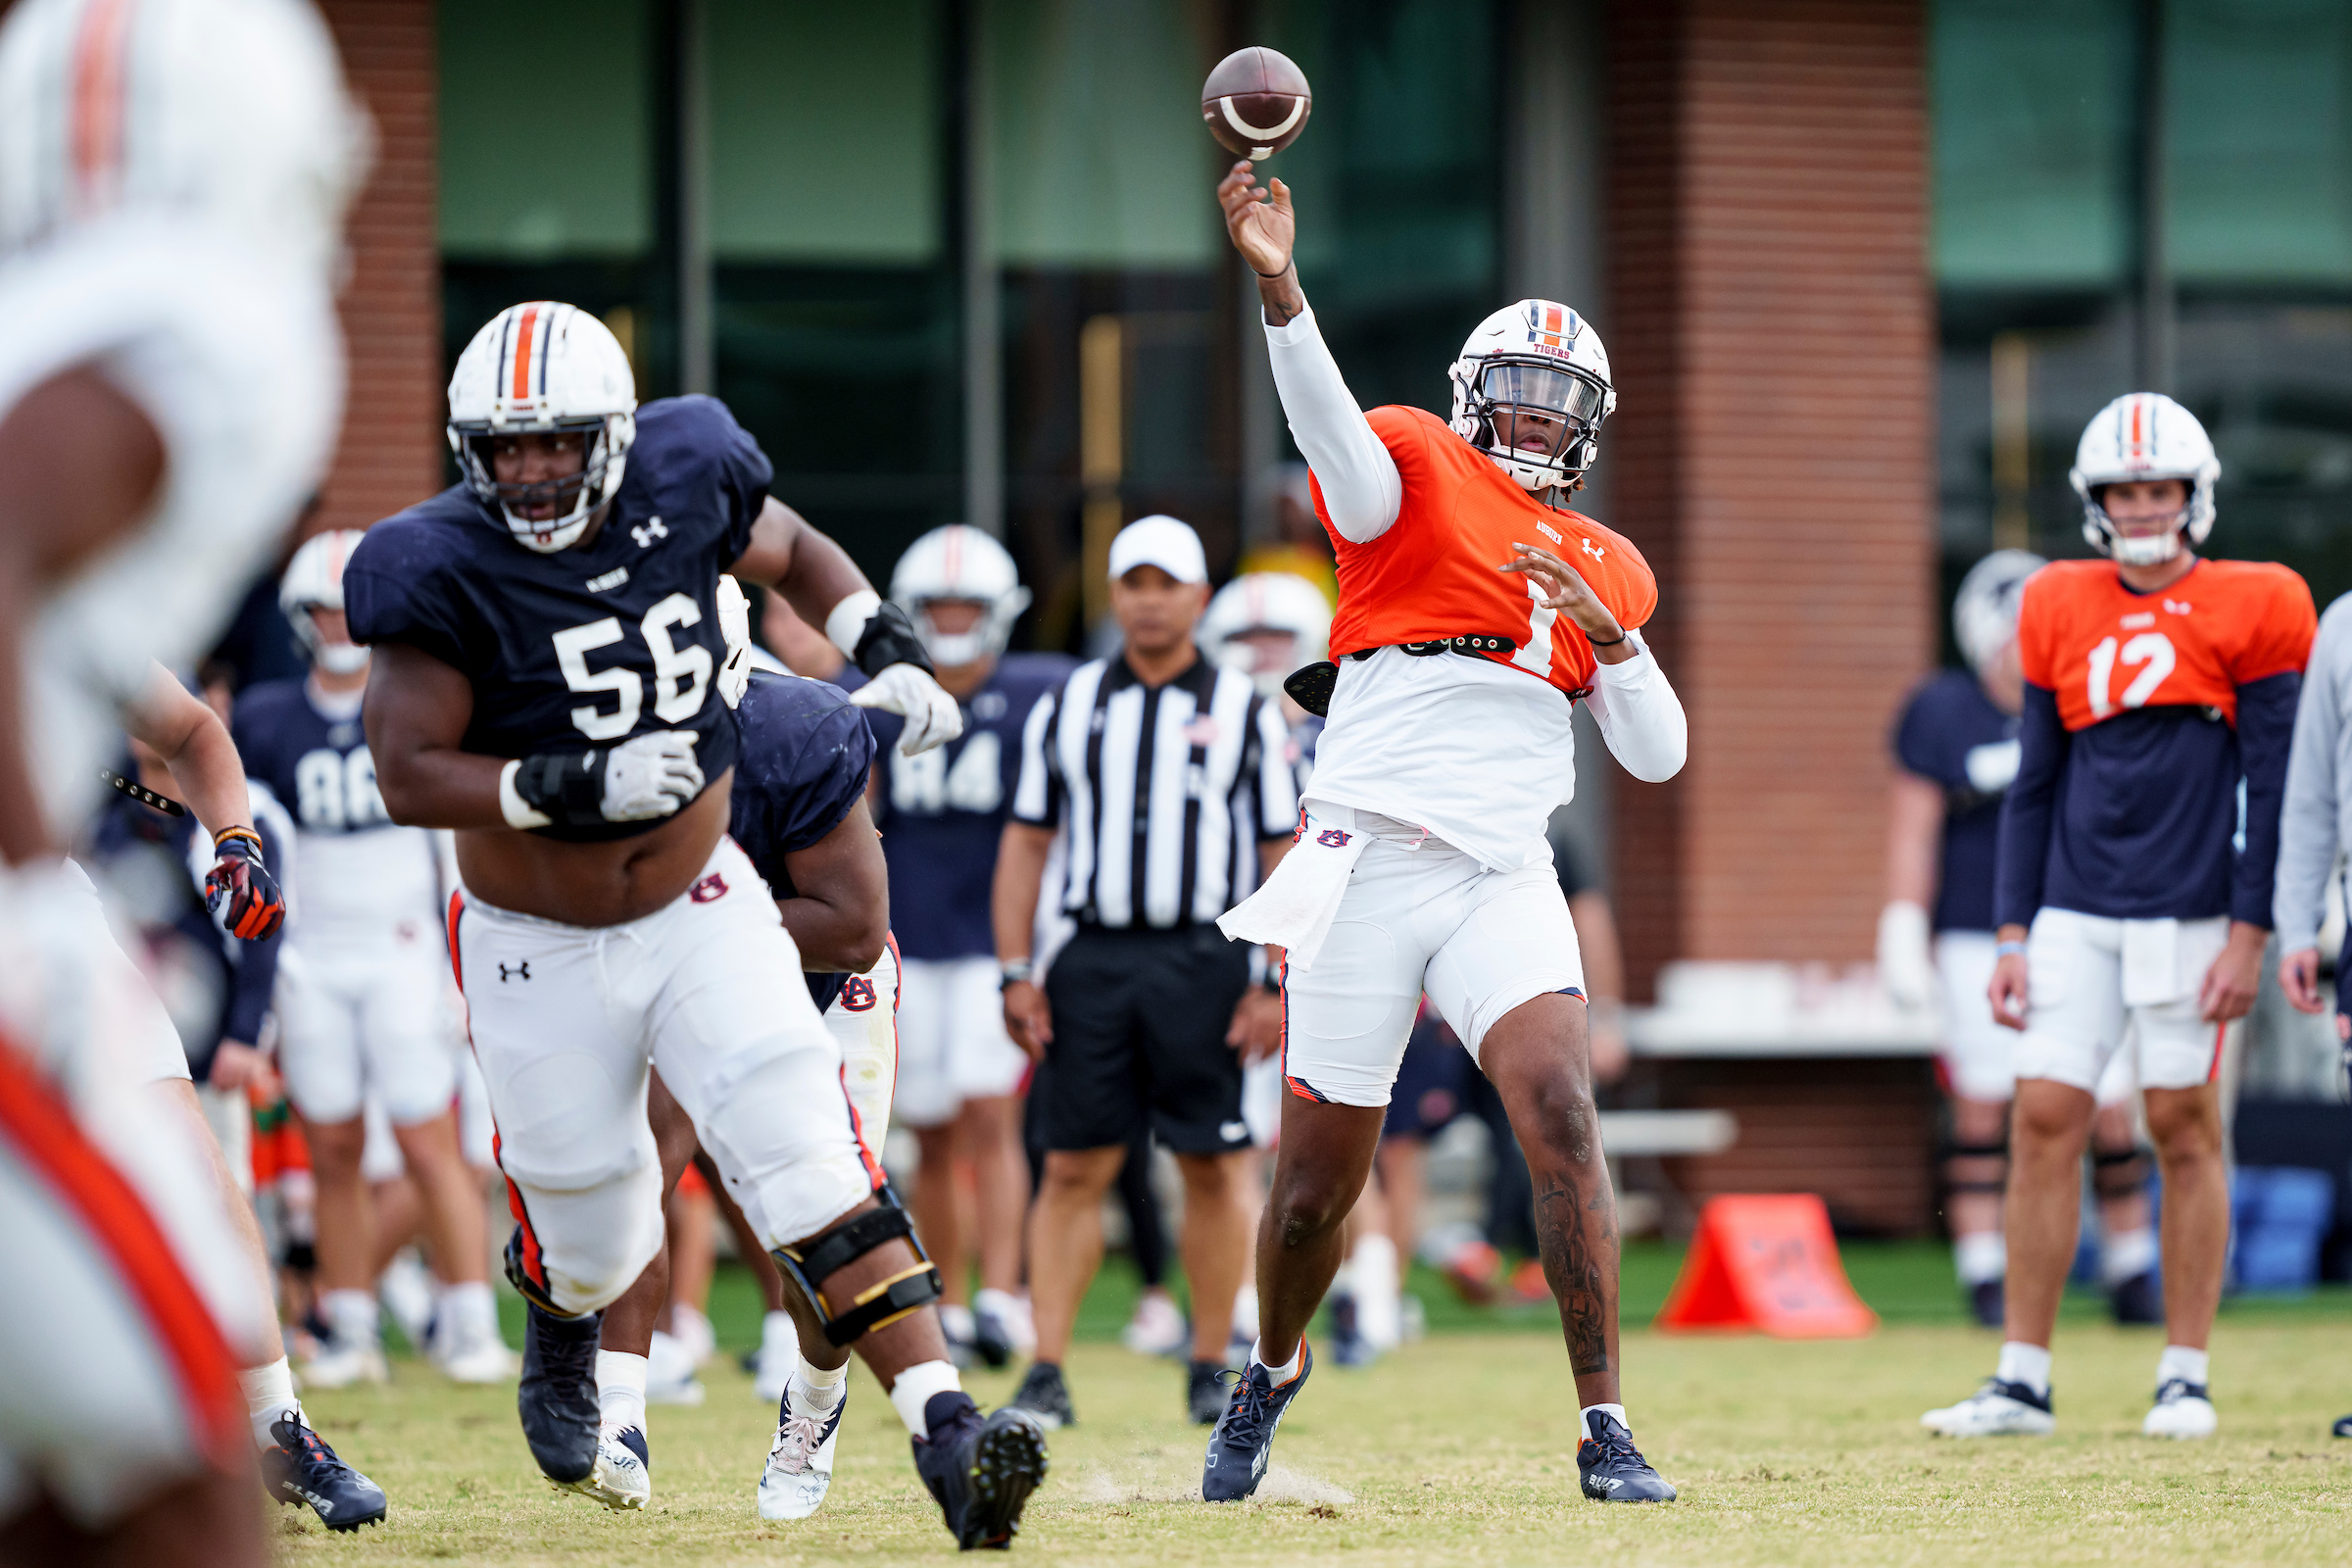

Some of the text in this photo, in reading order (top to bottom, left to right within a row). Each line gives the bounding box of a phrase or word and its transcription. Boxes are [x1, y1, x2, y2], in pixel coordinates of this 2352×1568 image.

[1534, 343, 1570, 360] TIGERS
[1536, 520, 1563, 546] AUBURN
[551, 592, 703, 741] 56
[2087, 632, 2177, 720] 12
